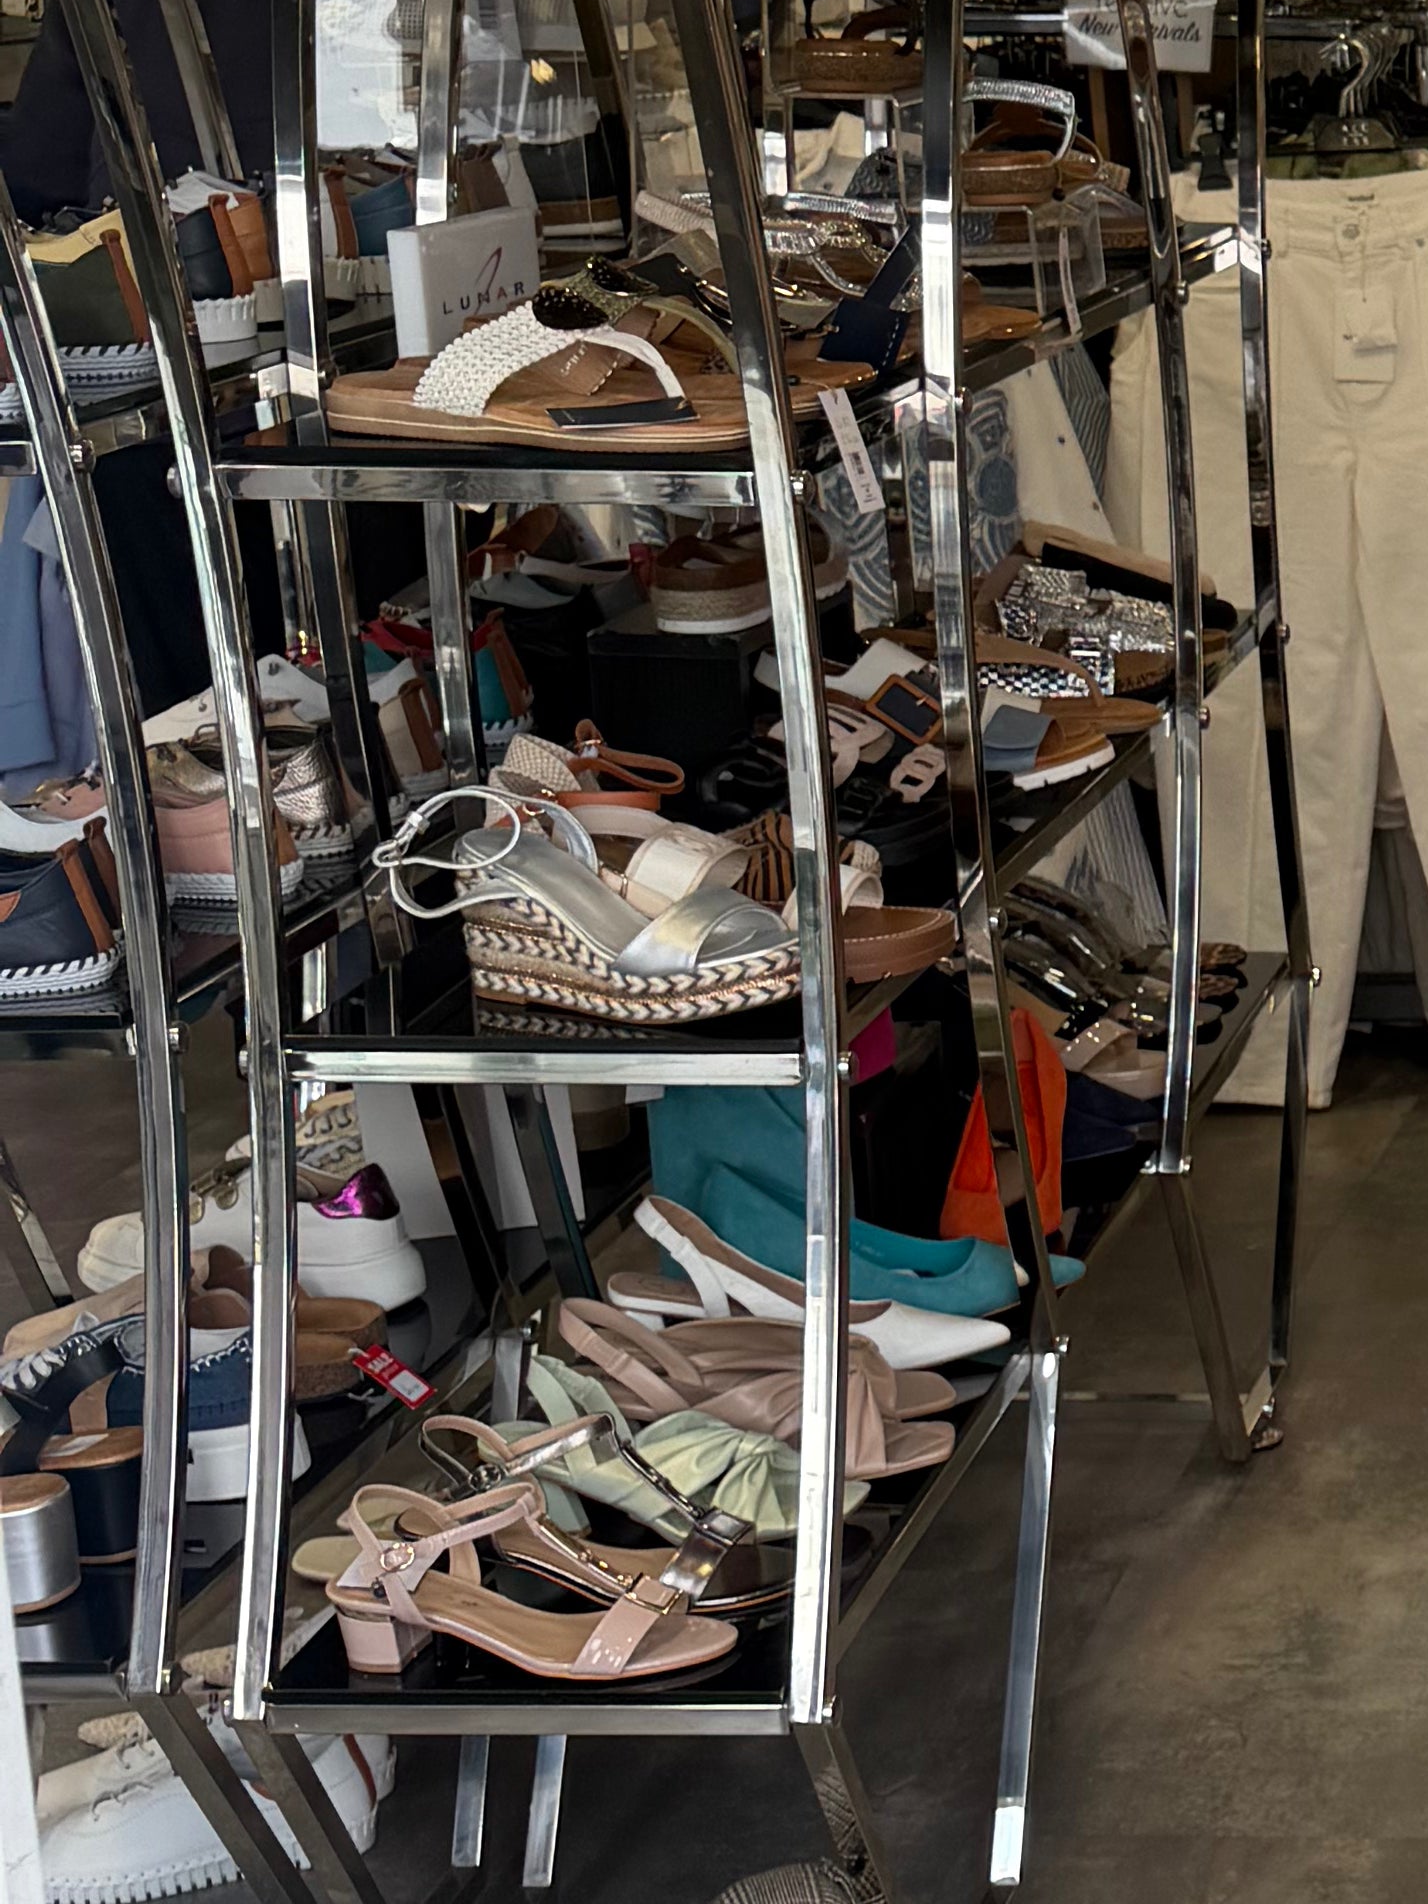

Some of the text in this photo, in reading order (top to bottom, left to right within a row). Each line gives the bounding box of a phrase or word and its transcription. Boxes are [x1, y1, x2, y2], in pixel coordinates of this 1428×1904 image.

[1079, 14, 1200, 43] New ivals
[443, 281, 525, 315] LUNAR
